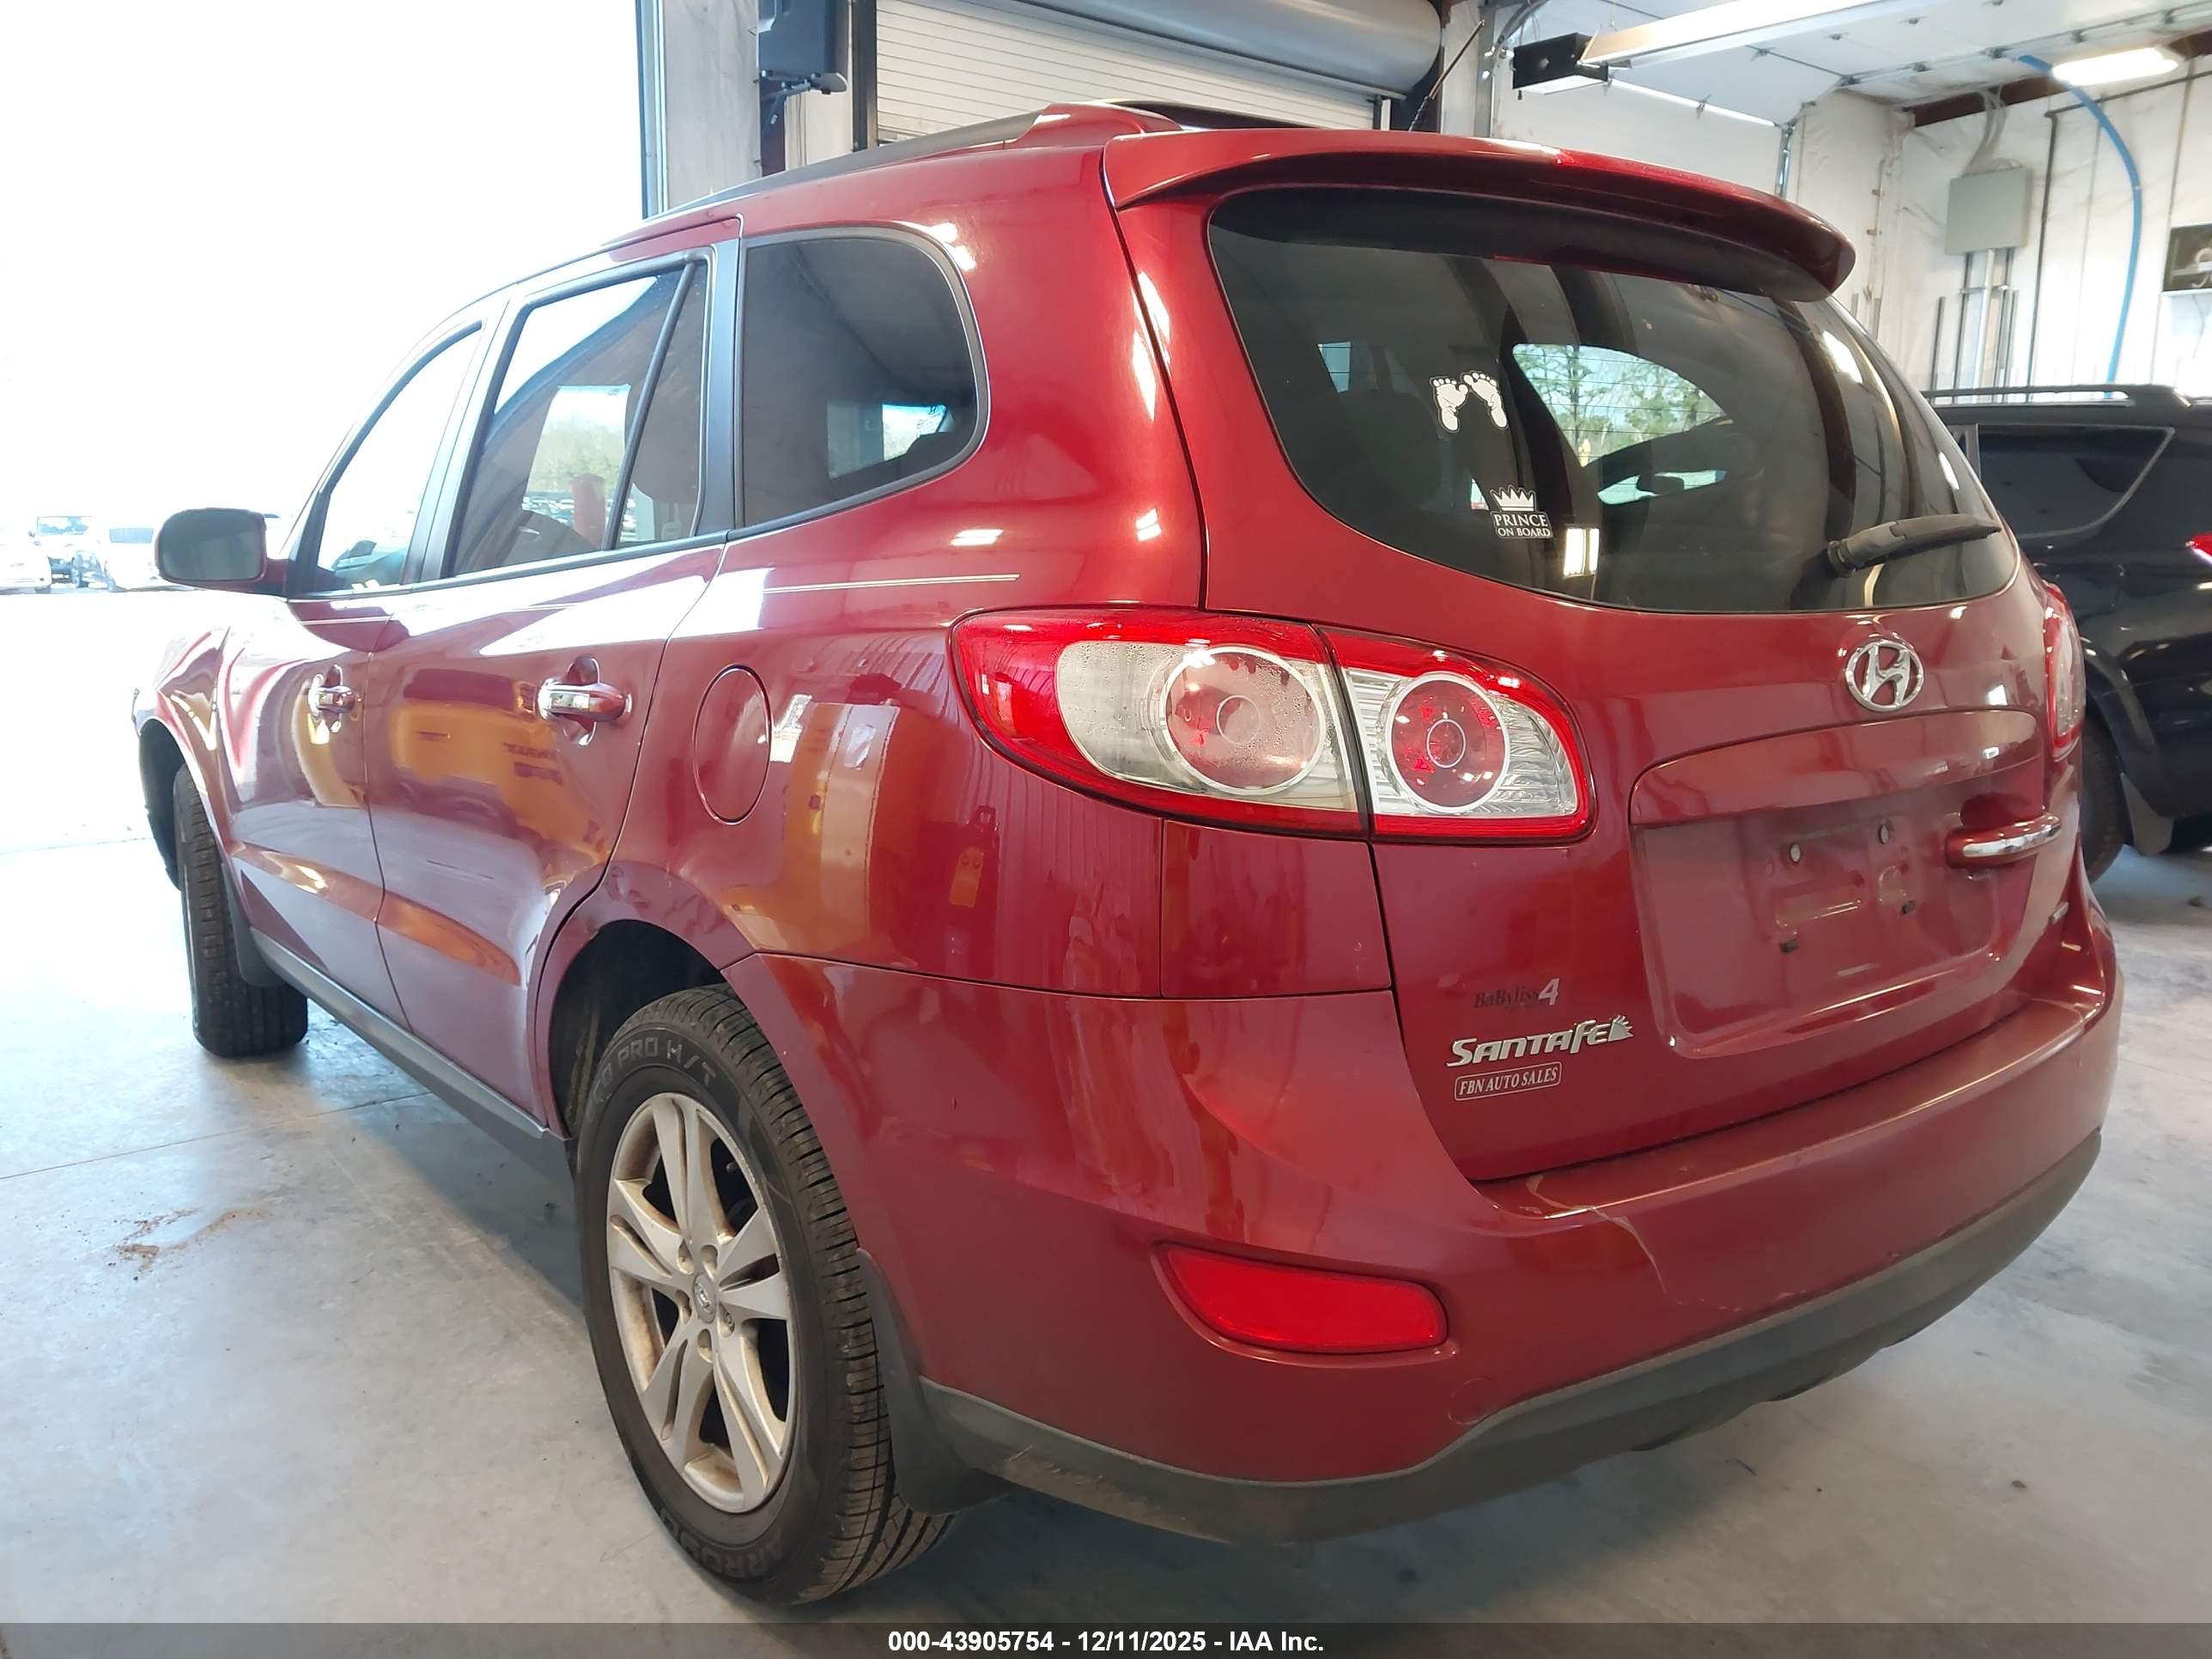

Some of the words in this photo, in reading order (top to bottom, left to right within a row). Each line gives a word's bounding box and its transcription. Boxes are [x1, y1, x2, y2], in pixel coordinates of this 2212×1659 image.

[1494, 514, 1547, 526] PRINCE
[1498, 527, 1514, 537] ON
[1516, 527, 1551, 537] BOARD
[617, 1037, 659, 1067] PRO
[1459, 1081, 1487, 1096] FBN
[1486, 1073, 1519, 1092] AUTO
[1521, 1067, 1557, 1085] SALES
